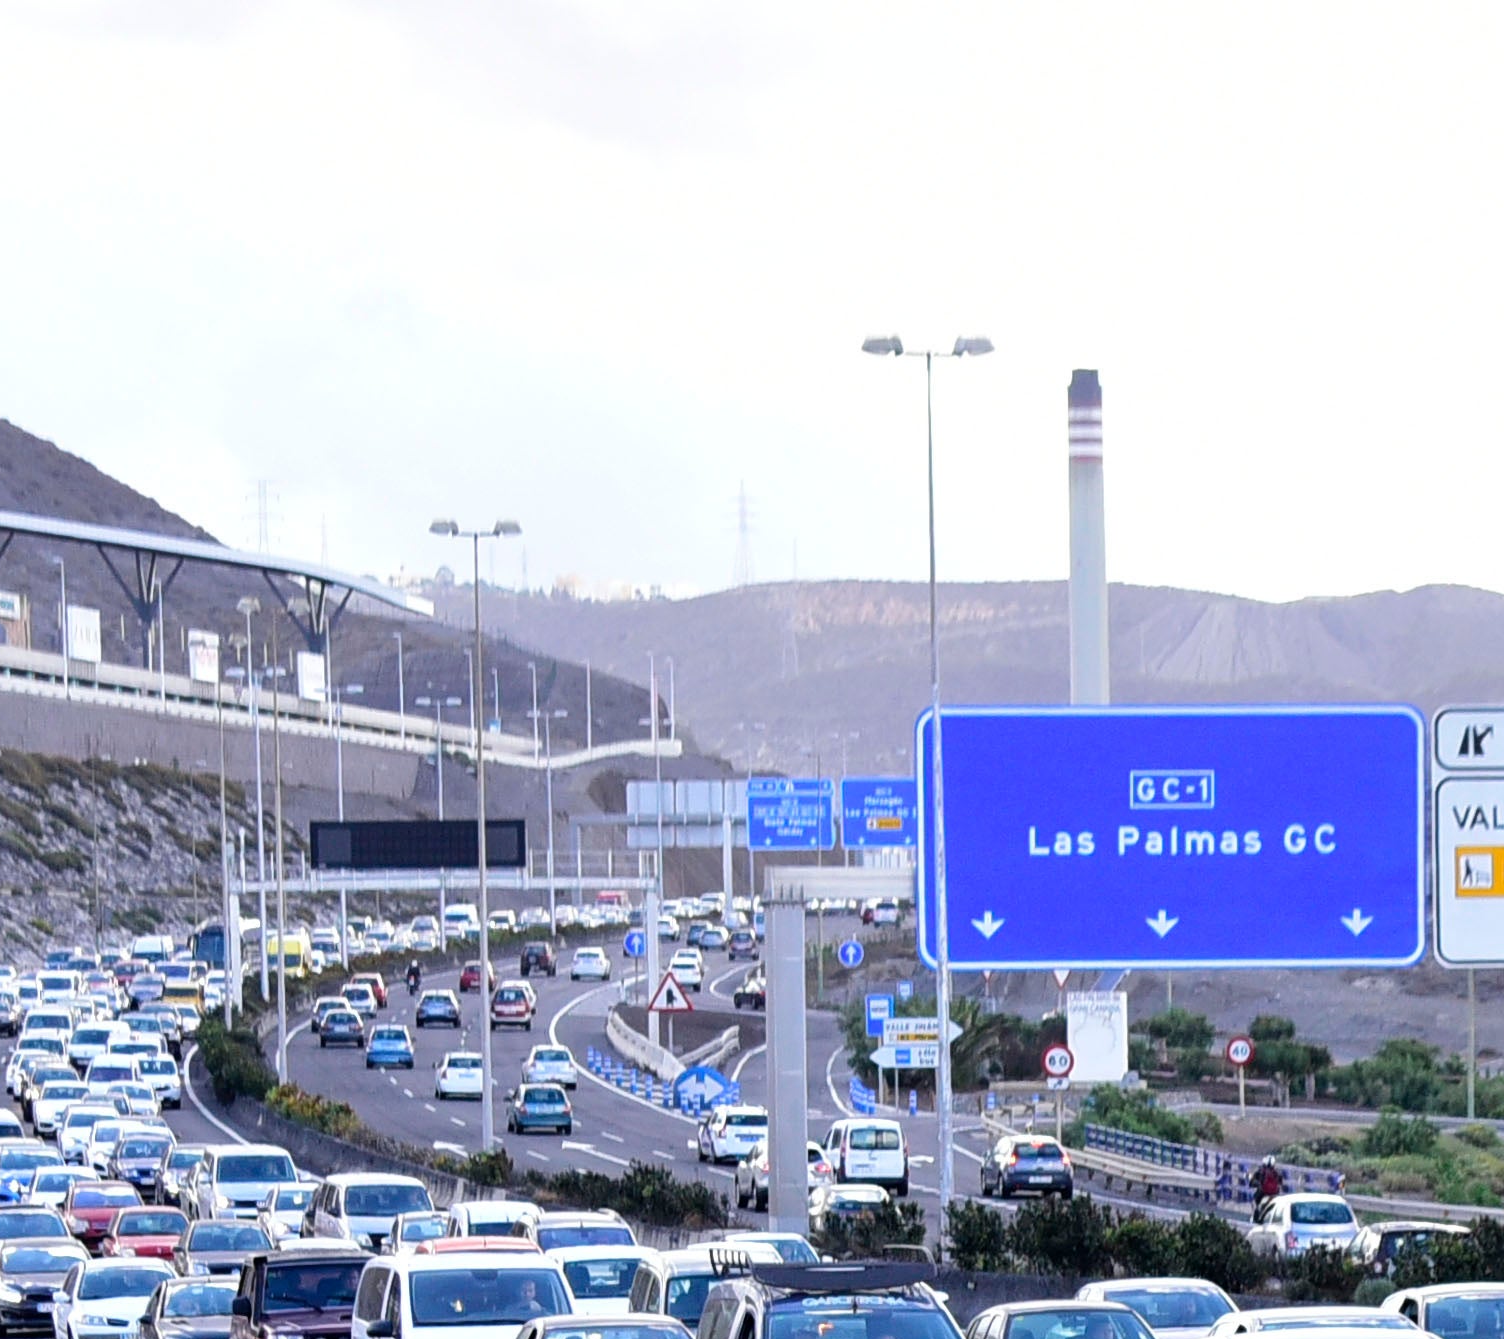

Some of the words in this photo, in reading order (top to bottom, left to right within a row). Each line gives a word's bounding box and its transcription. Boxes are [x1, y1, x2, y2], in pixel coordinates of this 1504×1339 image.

[1136, 777, 1209, 802] GC-1
[1028, 825, 1096, 856] Las
[1117, 825, 1262, 856] Palmas
[1283, 823, 1336, 855] GC
[1232, 1045, 1248, 1057] 40
